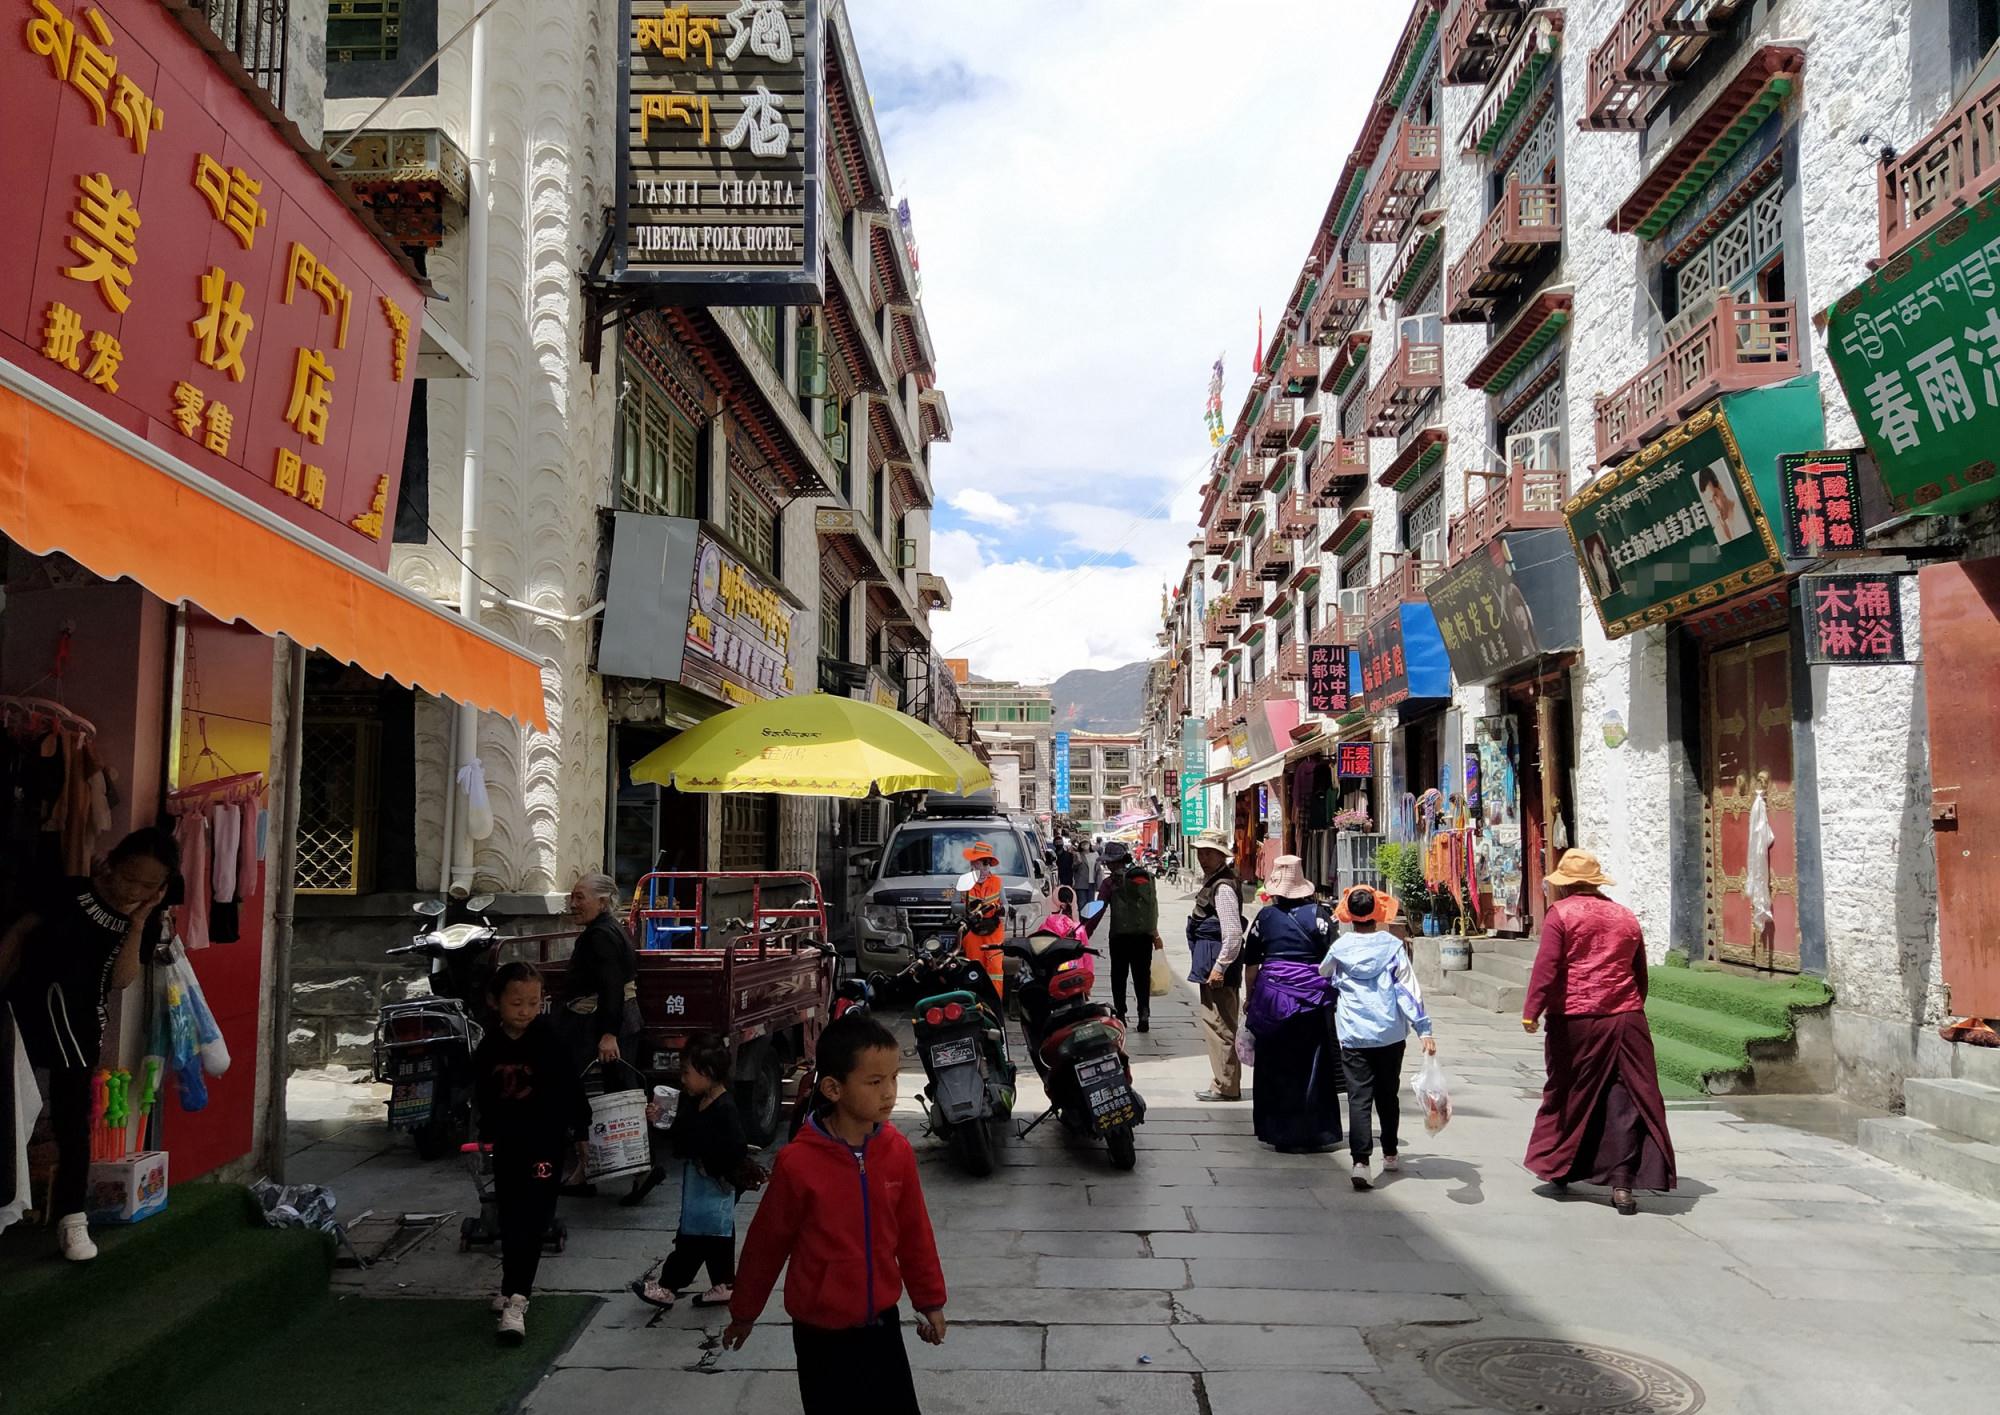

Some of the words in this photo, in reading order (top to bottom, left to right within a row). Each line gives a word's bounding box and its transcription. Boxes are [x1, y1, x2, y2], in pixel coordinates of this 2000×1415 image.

[637, 180, 699, 204] TASHI
[720, 180, 796, 204] CHOETA
[636, 226, 698, 251] TIBETAN
[703, 226, 742, 251] FOLK
[746, 226, 793, 251] HOTEL
[44, 302, 125, 393] 批发
[171, 380, 235, 456] 零售
[275, 447, 327, 510] 团购
[1794, 479, 1825, 546] 烧烤
[1822, 476, 1854, 545] 酸辣粉
[1815, 582, 1891, 617] 木桶
[1819, 619, 1895, 656] 淋浴
[1312, 648, 1329, 710] 成都小吃
[1329, 647, 1347, 710] 川味中餐
[1341, 760, 1370, 774] 川菜
[1342, 746, 1370, 760] 正宗
[110, 919, 130, 934] LIK
[666, 995, 685, 1015] 鸽
